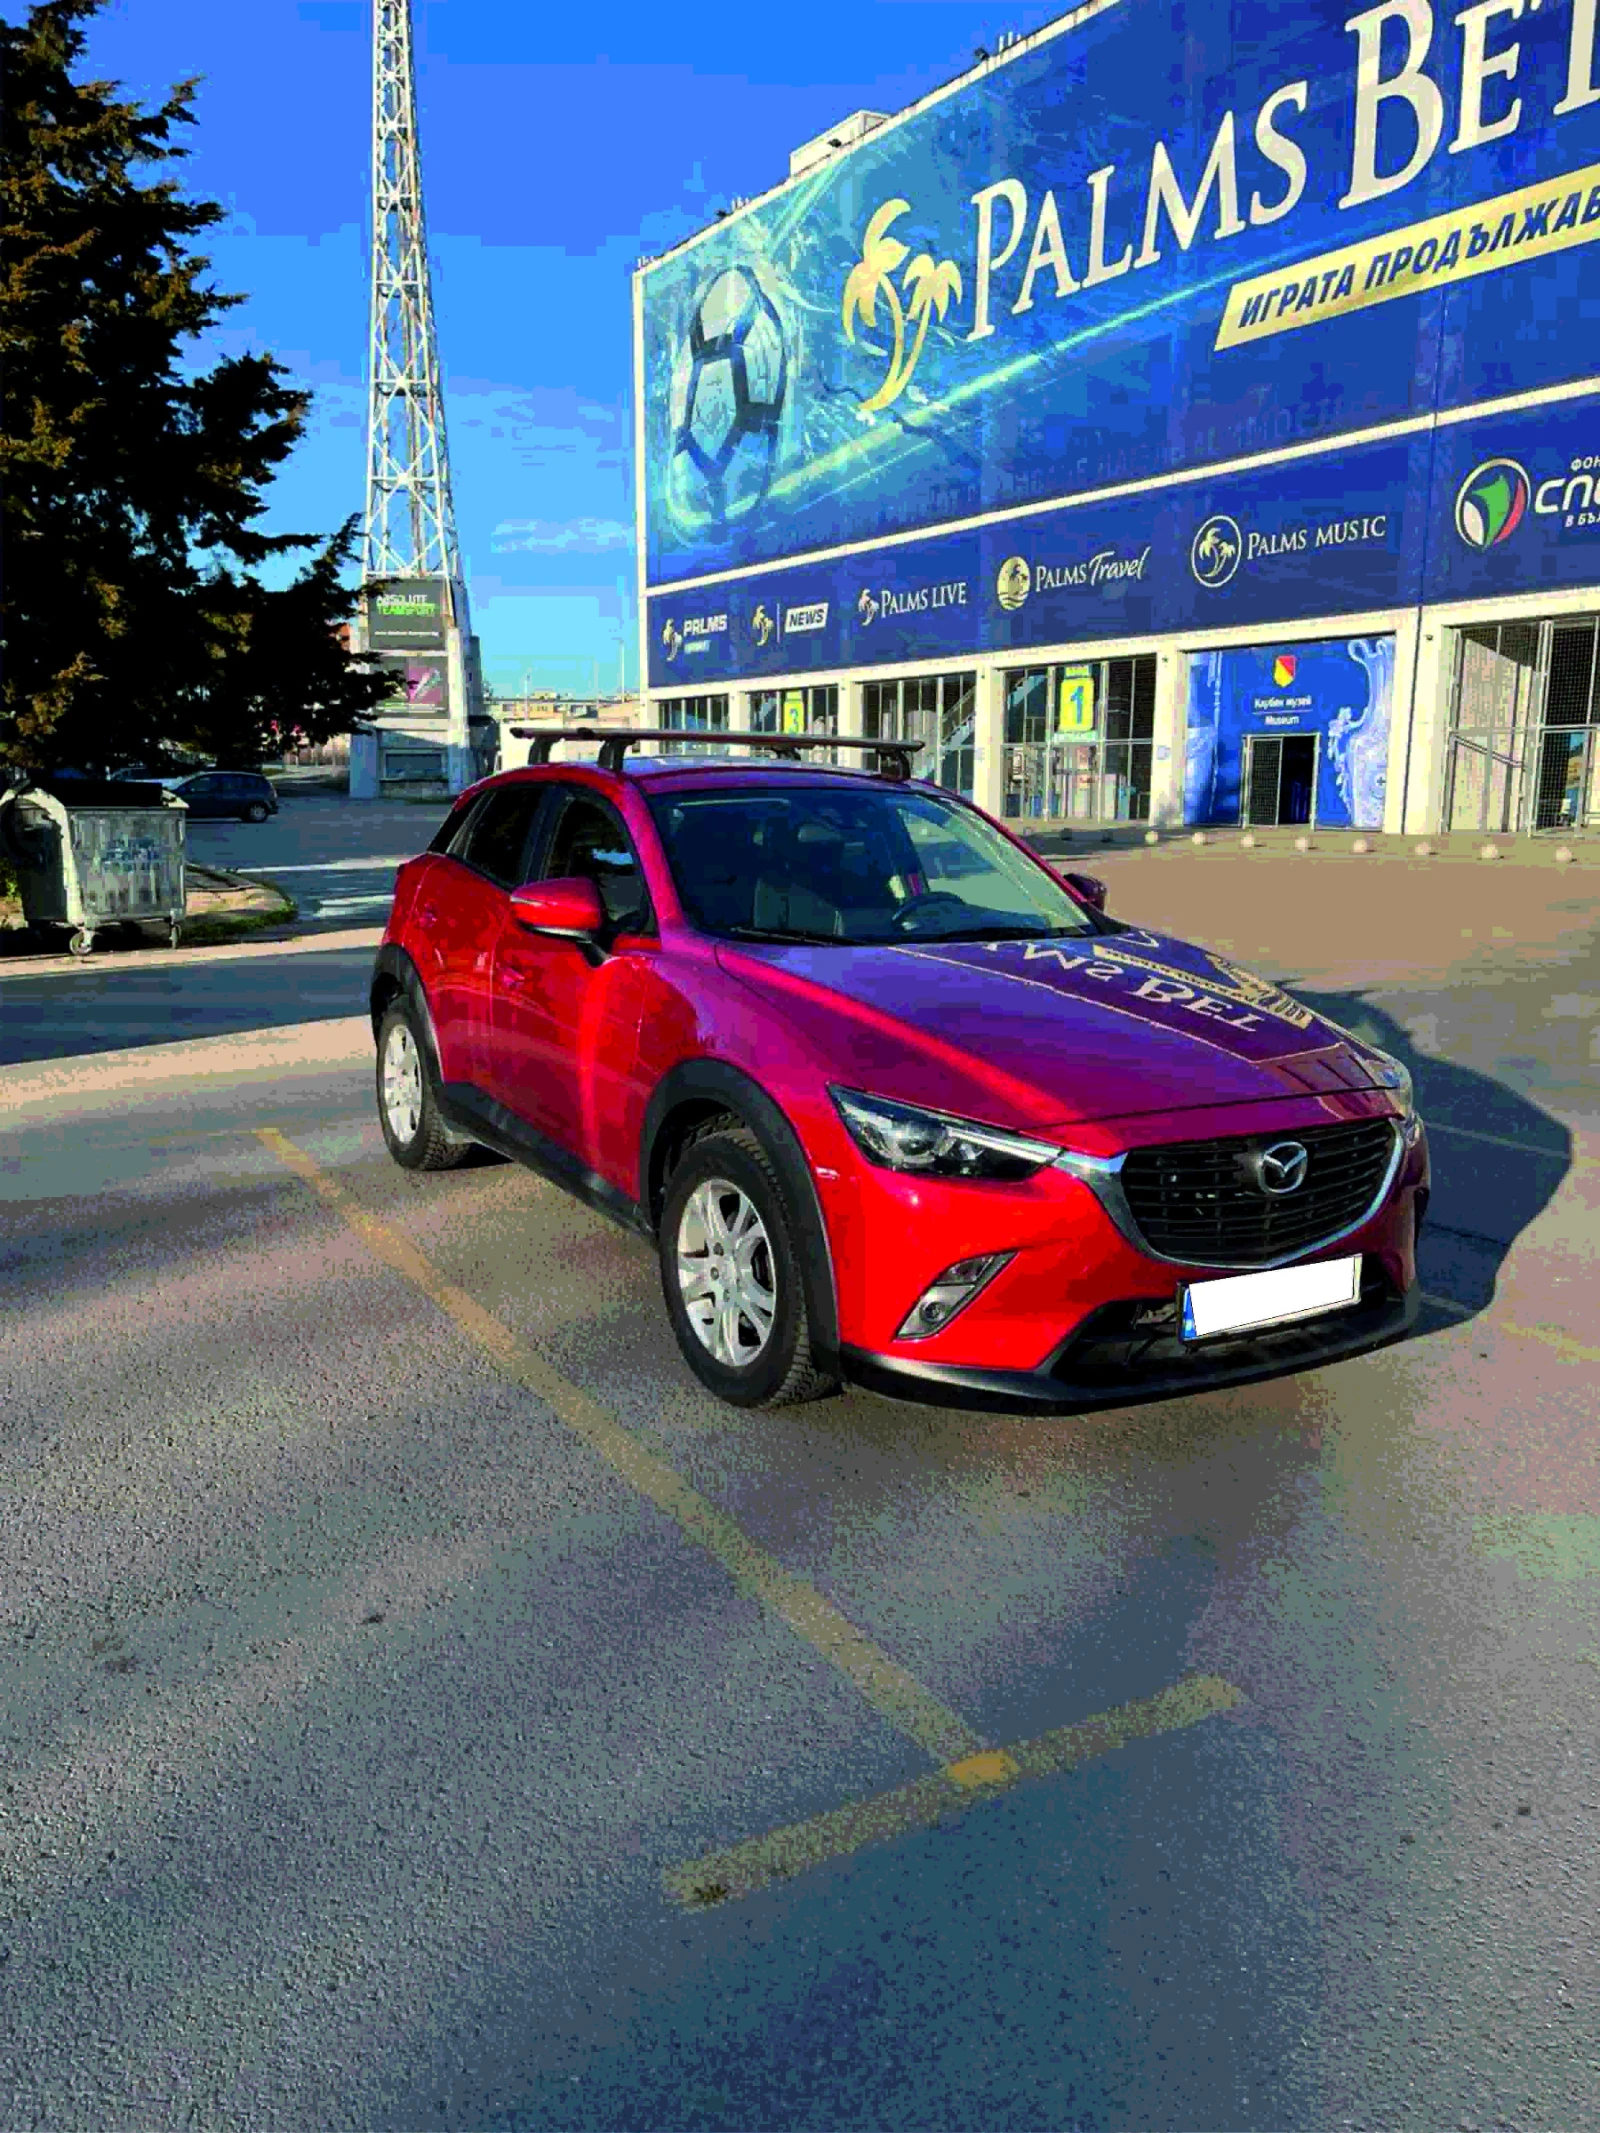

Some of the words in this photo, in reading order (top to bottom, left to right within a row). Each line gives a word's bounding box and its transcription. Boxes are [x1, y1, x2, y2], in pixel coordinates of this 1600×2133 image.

[967, 80, 1307, 343] PALMS
[1238, 262, 1357, 329] ИГРАТА
[1247, 528, 1308, 560] PALMS
[1315, 515, 1387, 548] MUSIC
[1035, 563, 1088, 592] PALMS
[1088, 545, 1152, 587] Travel
[788, 607, 825, 628] NEWS
[881, 588, 929, 618] PALMS
[931, 582, 967, 608] LIVE
[683, 614, 728, 638] PALMS
[1070, 685, 1085, 725] 1
